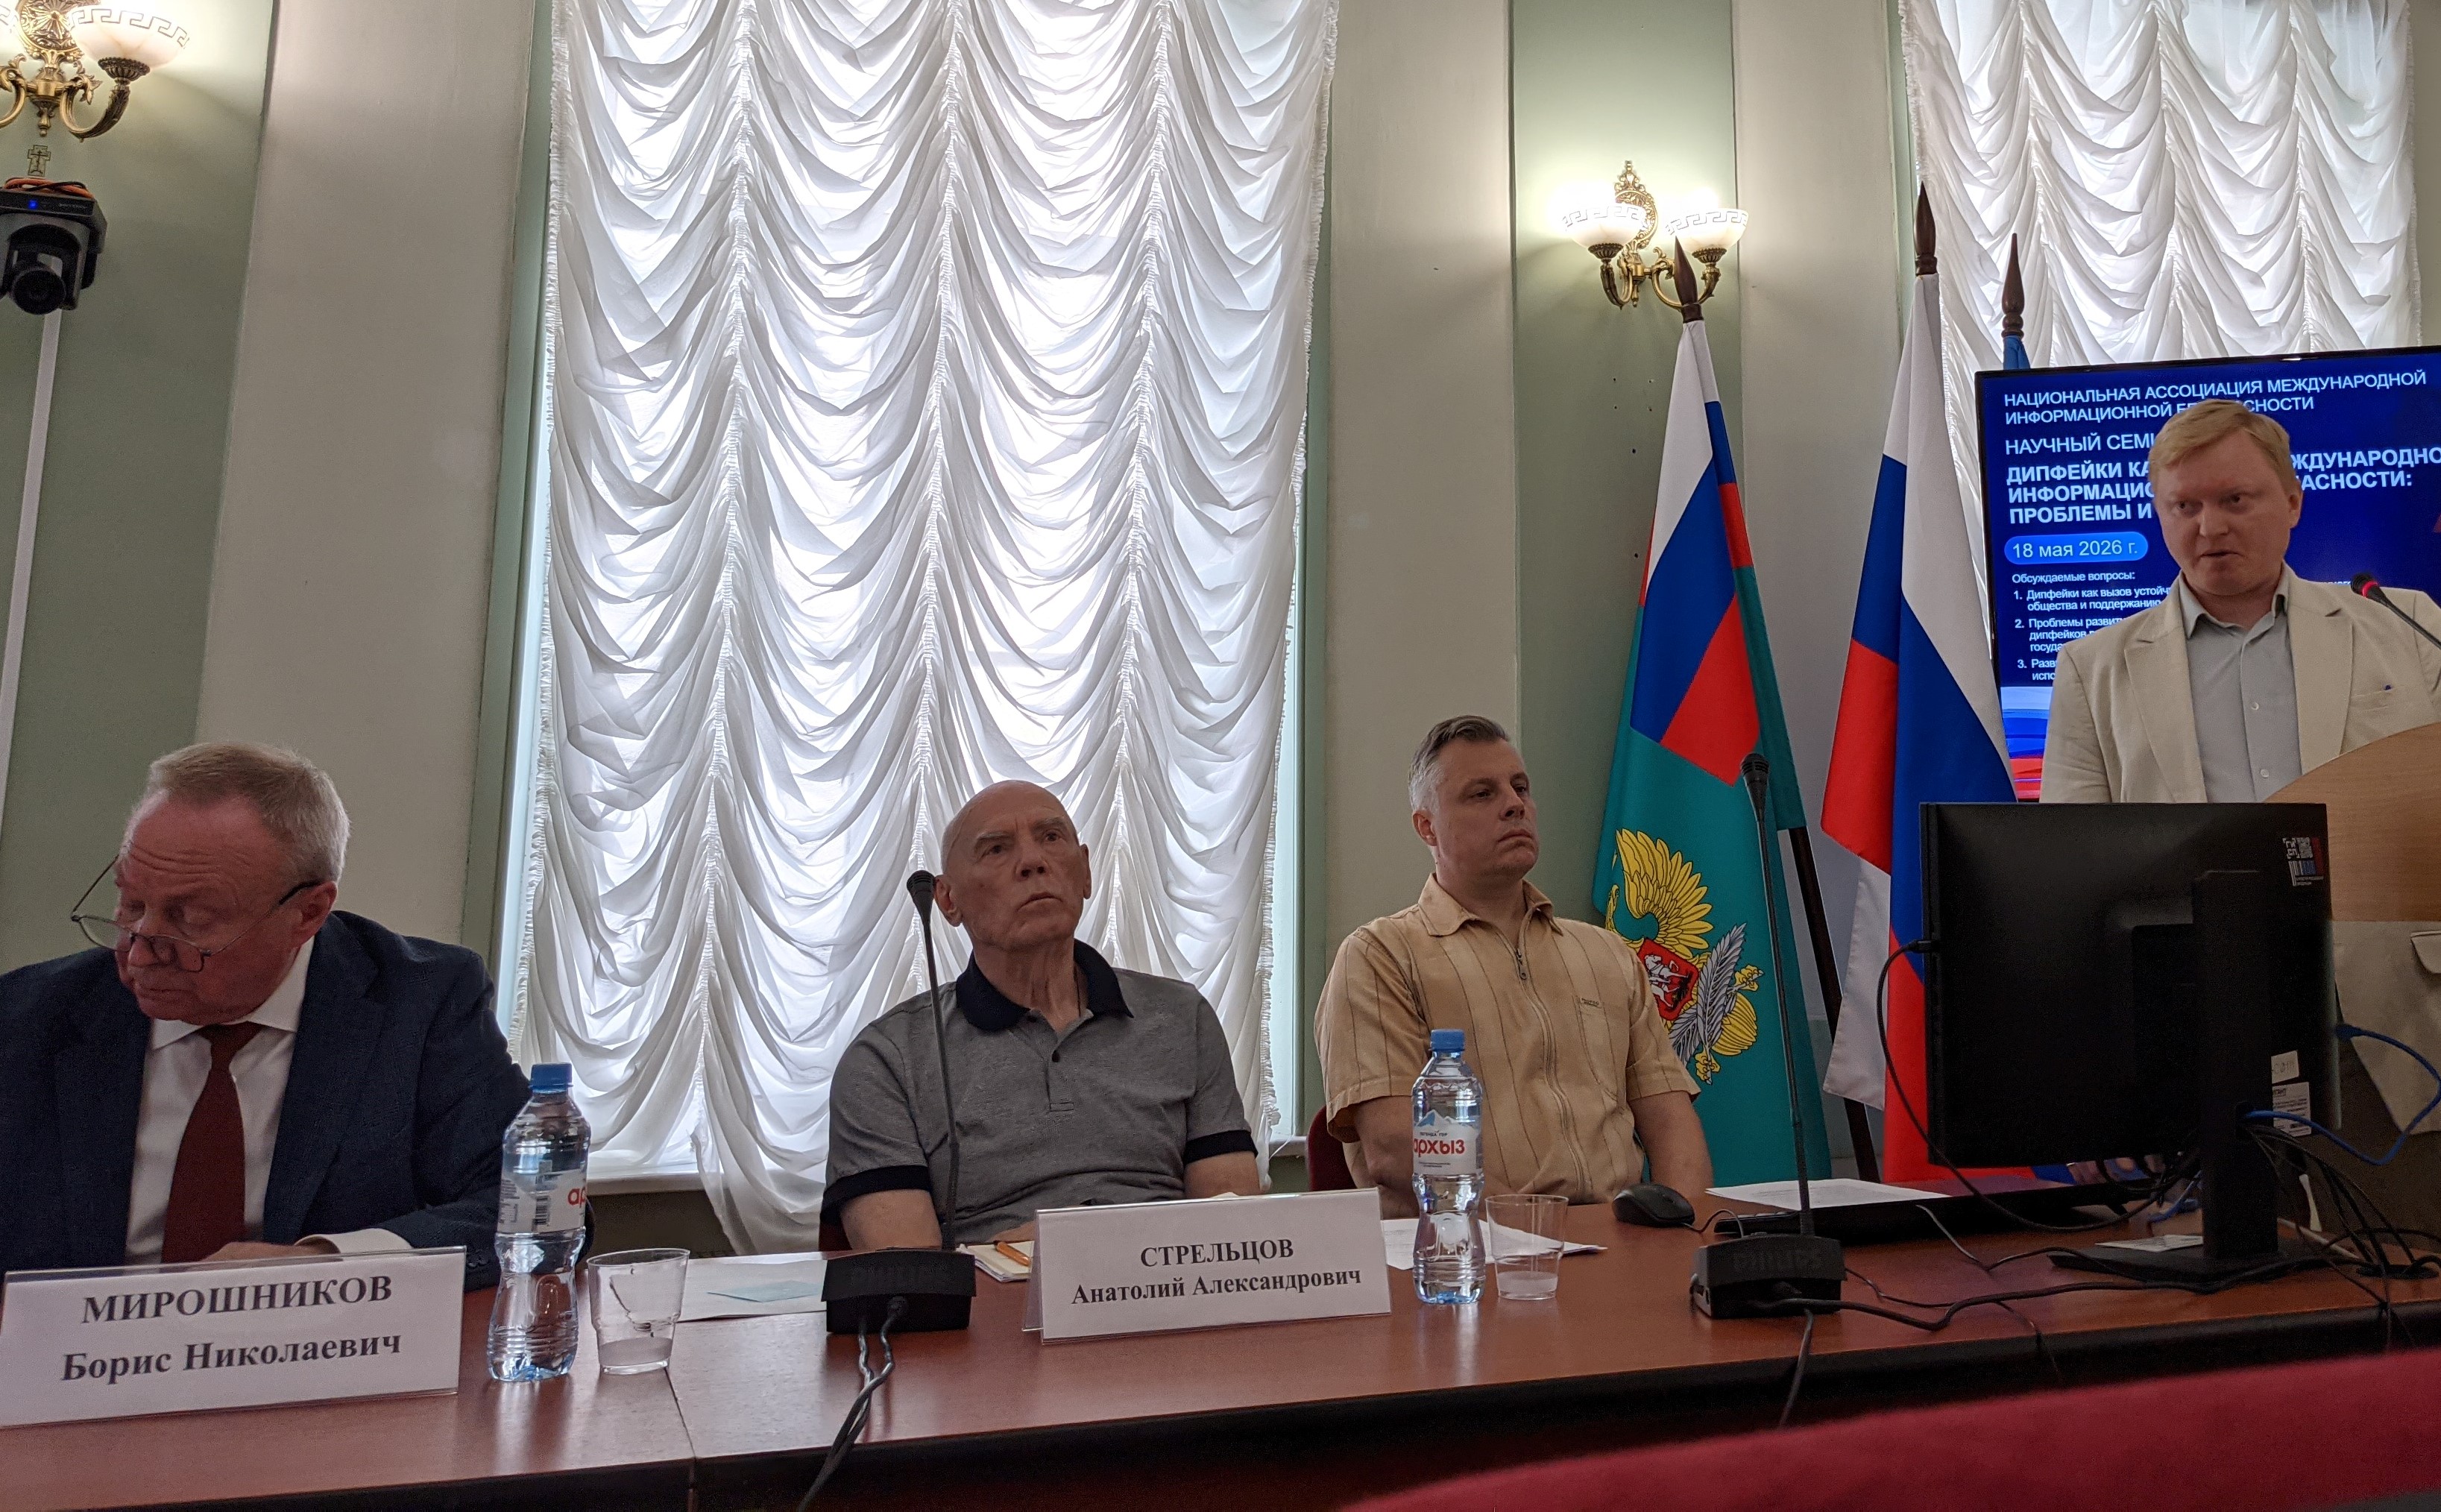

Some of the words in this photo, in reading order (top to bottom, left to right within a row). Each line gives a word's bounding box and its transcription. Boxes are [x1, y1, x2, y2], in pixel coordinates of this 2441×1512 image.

[2004, 387, 2141, 408] НАЦИОНАЛЬНАЯ
[2145, 380, 2263, 400] АССОЦИАЦИЯ
[2267, 369, 2427, 393] МЕЖДУНАРОДНОЙ
[2006, 401, 2173, 425] ИНФОРМАЦИОННОЙ
[2006, 432, 2101, 455] НАУЧНЫЙ
[2006, 460, 2123, 485] ДИПФЕЙКИ
[2128, 461, 2149, 477] КА
[2290, 447, 2441, 473] ЖДУНАРОДНО
[2009, 482, 2155, 503] ИНФОРМАЦИО
[2296, 470, 2413, 491] АСНОСТИ:
[2009, 504, 2132, 523] ПРОБЛЕМЫ
[2138, 503, 2152, 519] И
[2012, 543, 2033, 558] 18
[2039, 544, 2073, 558] мая
[2079, 540, 2123, 556] 2026
[2128, 542, 2138, 555] г.
[2012, 573, 2086, 585] Обсуждаемые
[2088, 571, 2135, 583] вопросы:
[2014, 590, 2023, 599] 1.
[2026, 589, 2079, 602] Дипфейки
[2100, 588, 2132, 597] вызов
[2134, 585, 2170, 599] устойч
[2027, 602, 2078, 611] общества
[2015, 619, 2024, 629] 2.
[2029, 617, 2083, 630] Проблемы
[2085, 617, 2125, 629] развит
[2029, 629, 2087, 641] дипфейков
[2030, 643, 2063, 653] госуда
[2017, 659, 2027, 669] 3.
[2032, 658, 2057, 669] Разв
[2032, 672, 2056, 681] испо
[567, 1186, 586, 1208] ар
[1140, 1238, 1294, 1267] СТРЕЛЬЦОВ
[1071, 1277, 1185, 1304] Анатолий
[1192, 1269, 1361, 1296] Александрович
[81, 1275, 392, 1323] МИРОШНИКОВ
[61, 1350, 171, 1385] Борис
[183, 1335, 401, 1372] Николаевич
